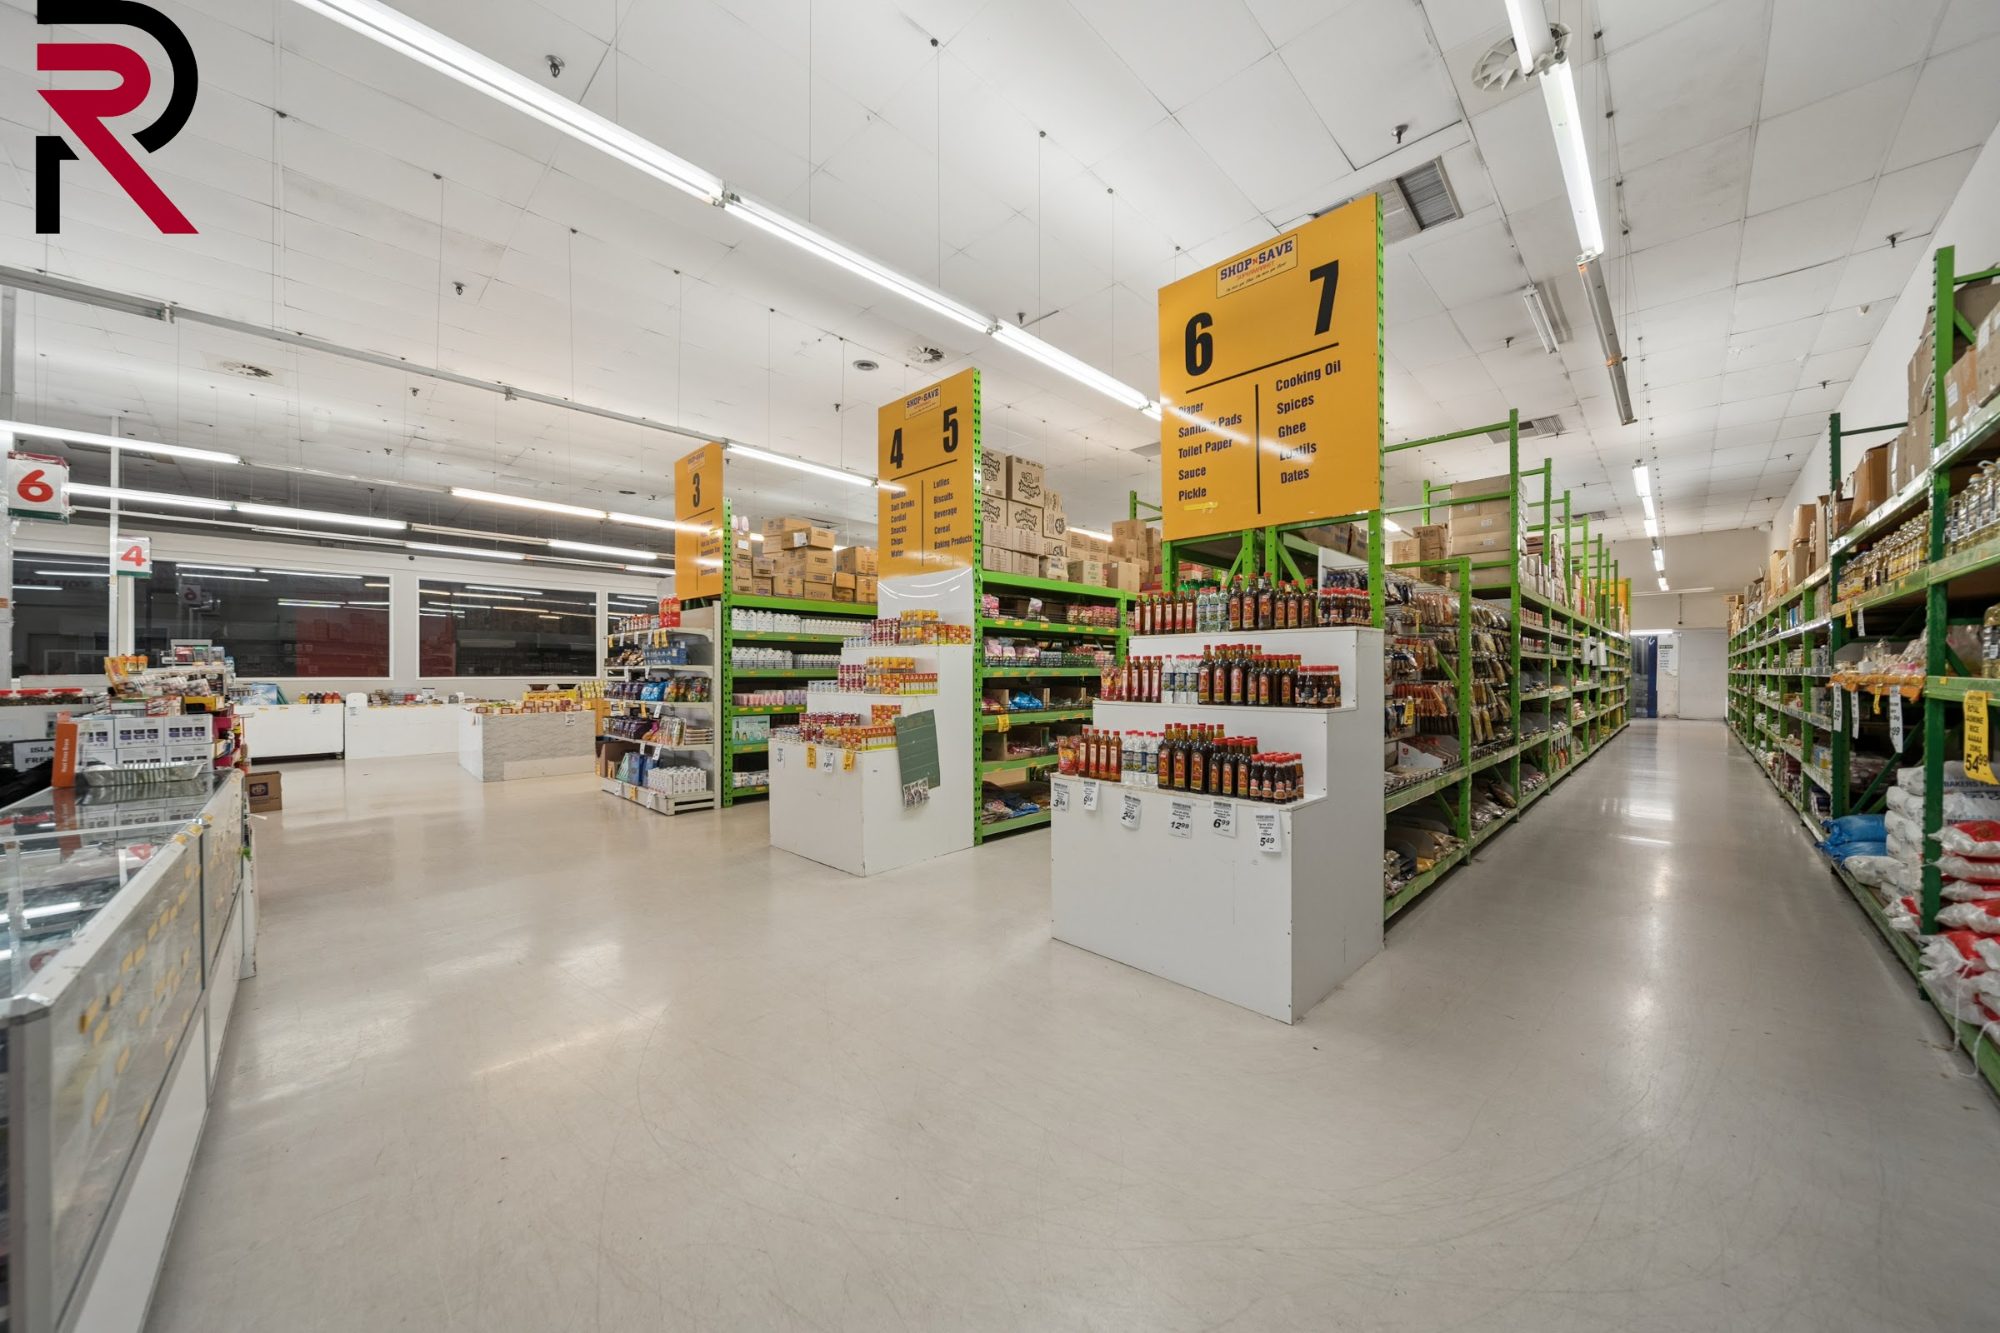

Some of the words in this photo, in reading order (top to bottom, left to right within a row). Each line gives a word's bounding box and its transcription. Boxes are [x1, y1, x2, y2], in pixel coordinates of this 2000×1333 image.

[1220, 257, 1252, 280] SHOP
[1259, 240, 1293, 264] SAVE
[1309, 259, 1339, 336] 7
[1185, 312, 1213, 377] 6
[1276, 368, 1321, 391] Cooking
[1325, 360, 1341, 375] Oil
[1277, 395, 1314, 414] Spices
[943, 406, 958, 453] 5
[1178, 419, 1217, 438] Sanita
[1218, 413, 1242, 428] Pads
[1278, 422, 1306, 438] Ghee
[890, 428, 904, 469] 4
[1178, 444, 1203, 459] Toilet
[1205, 438, 1233, 453] Paper
[1279, 442, 1317, 461] Ltils
[1178, 466, 1207, 481] Sauce
[1280, 468, 1309, 484] Dates
[17, 469, 54, 503] 6
[692, 472, 700, 508] 3
[1178, 487, 1207, 501] Pickle
[901, 499, 915, 509] Drinks
[933, 492, 954, 504] Biscuits
[891, 526, 907, 535] Snacks
[934, 524, 951, 534] Cereal
[891, 538, 903, 546] Chips
[934, 539, 950, 550] Baking
[951, 534, 973, 545] Products
[120, 545, 147, 567] 4
